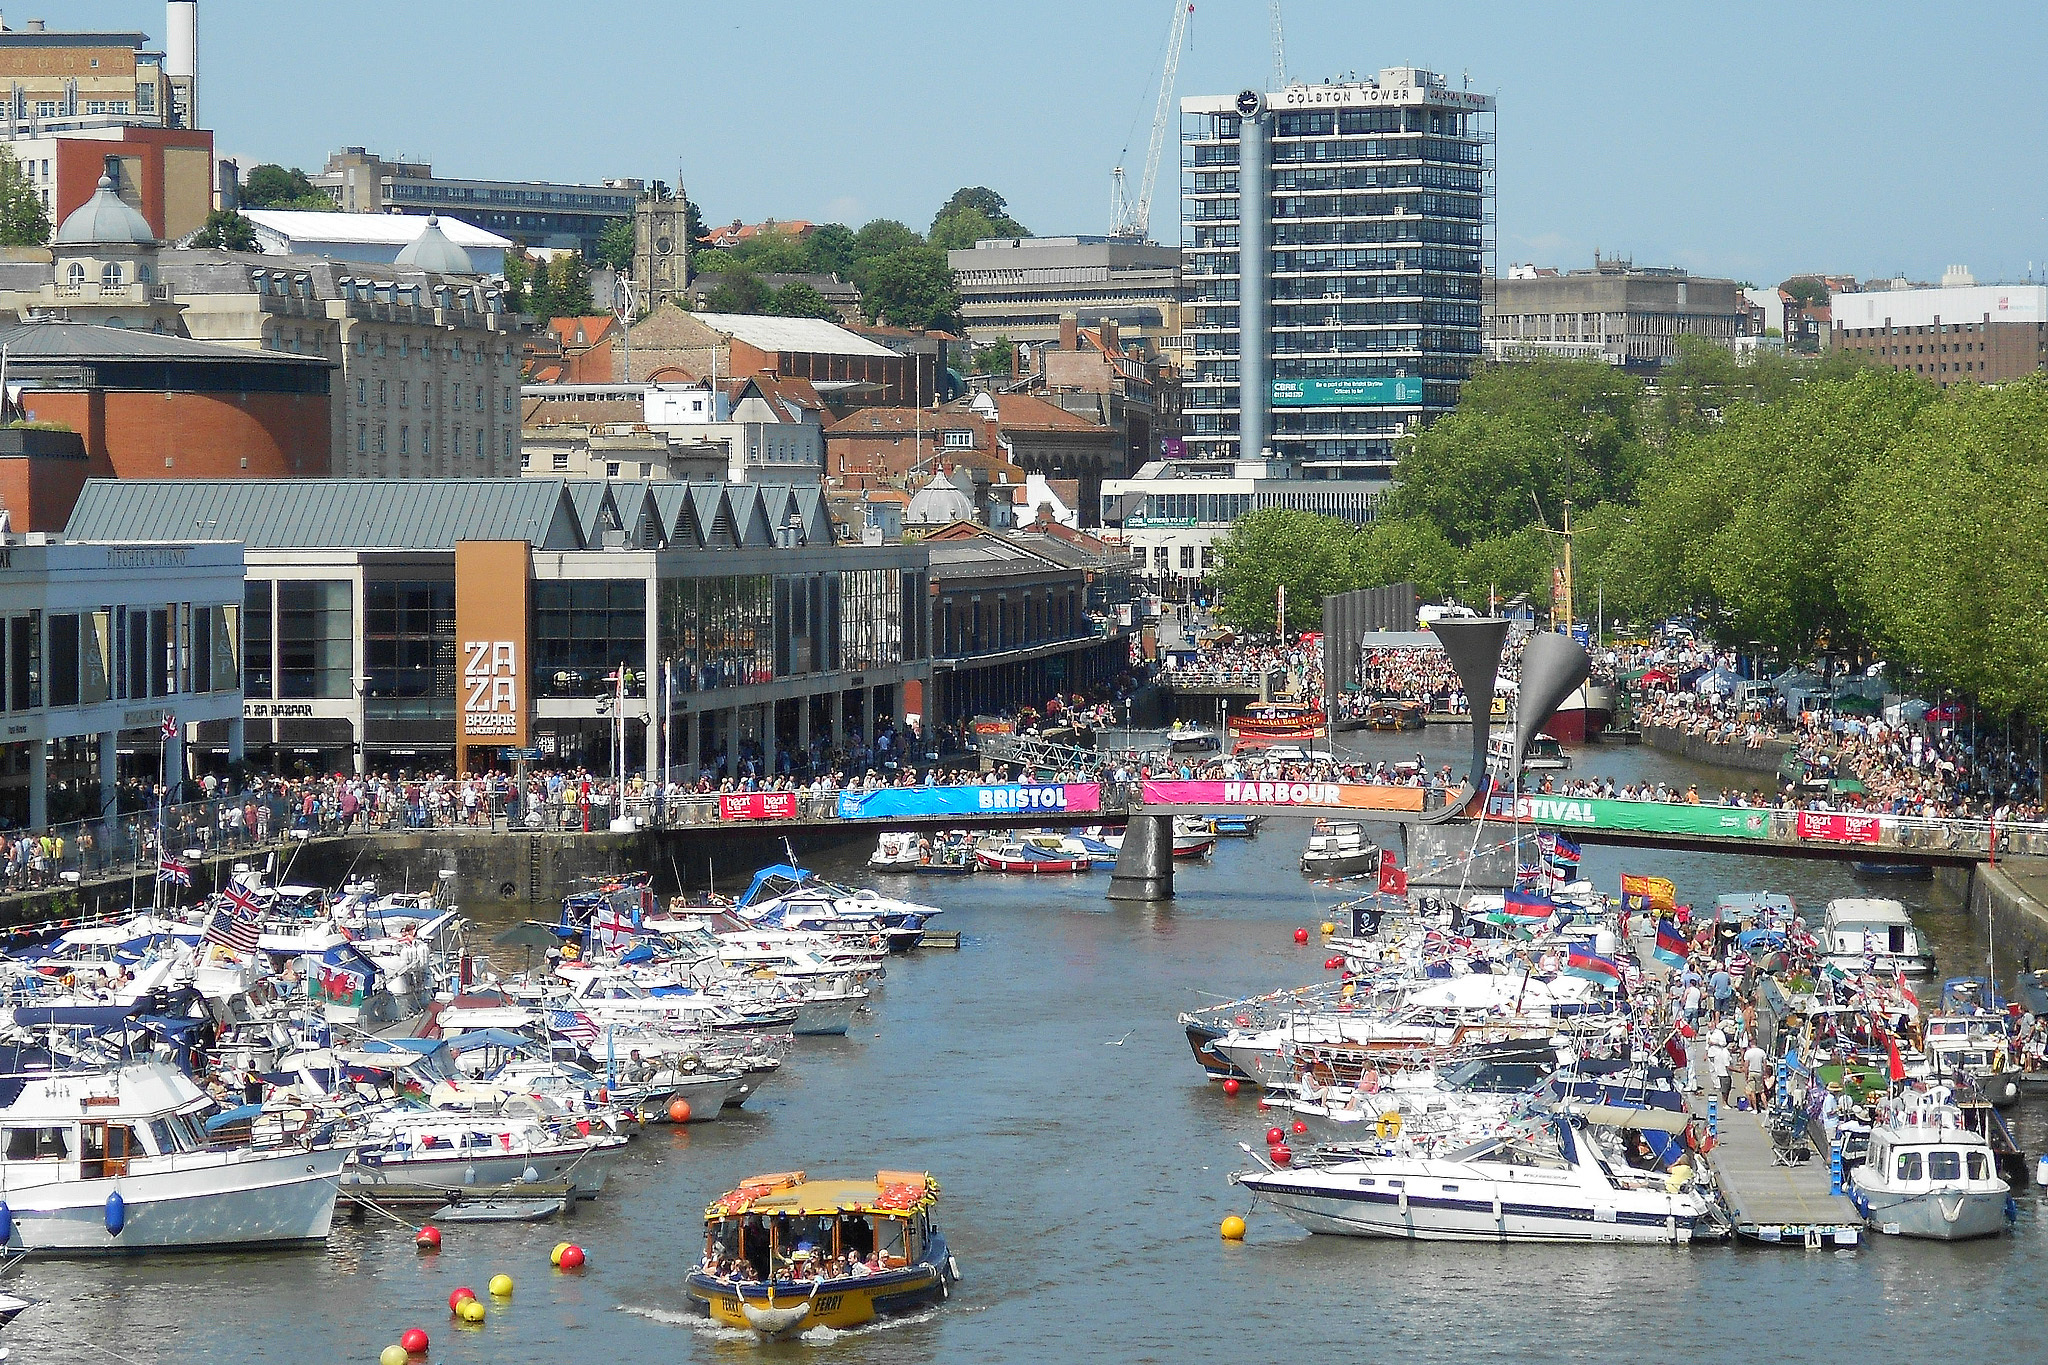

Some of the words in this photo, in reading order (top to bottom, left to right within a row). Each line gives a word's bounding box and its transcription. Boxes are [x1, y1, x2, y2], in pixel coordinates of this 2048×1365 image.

[1287, 90, 1351, 104] COLSTON
[1362, 89, 1409, 101] TOWER
[1273, 382, 1297, 391] CBRE
[107, 551, 146, 567] PITCHER
[159, 550, 187, 566] PIANO
[464, 641, 516, 676] ZA
[464, 677, 516, 712] ZA
[270, 704, 313, 717] BAZAAR
[464, 713, 517, 726] BAZAAR
[1302, 716, 1321, 724] Trips
[502, 727, 517, 735] BAR
[978, 787, 1068, 809] BRISTOL
[1224, 782, 1340, 803] HARBOUR
[726, 795, 751, 807] heart
[763, 794, 788, 805] heart
[1489, 796, 1596, 823] FESTIVAL
[1804, 813, 1832, 826] heart
[1845, 816, 1873, 829] heart
[814, 1295, 844, 1312] FERRY
